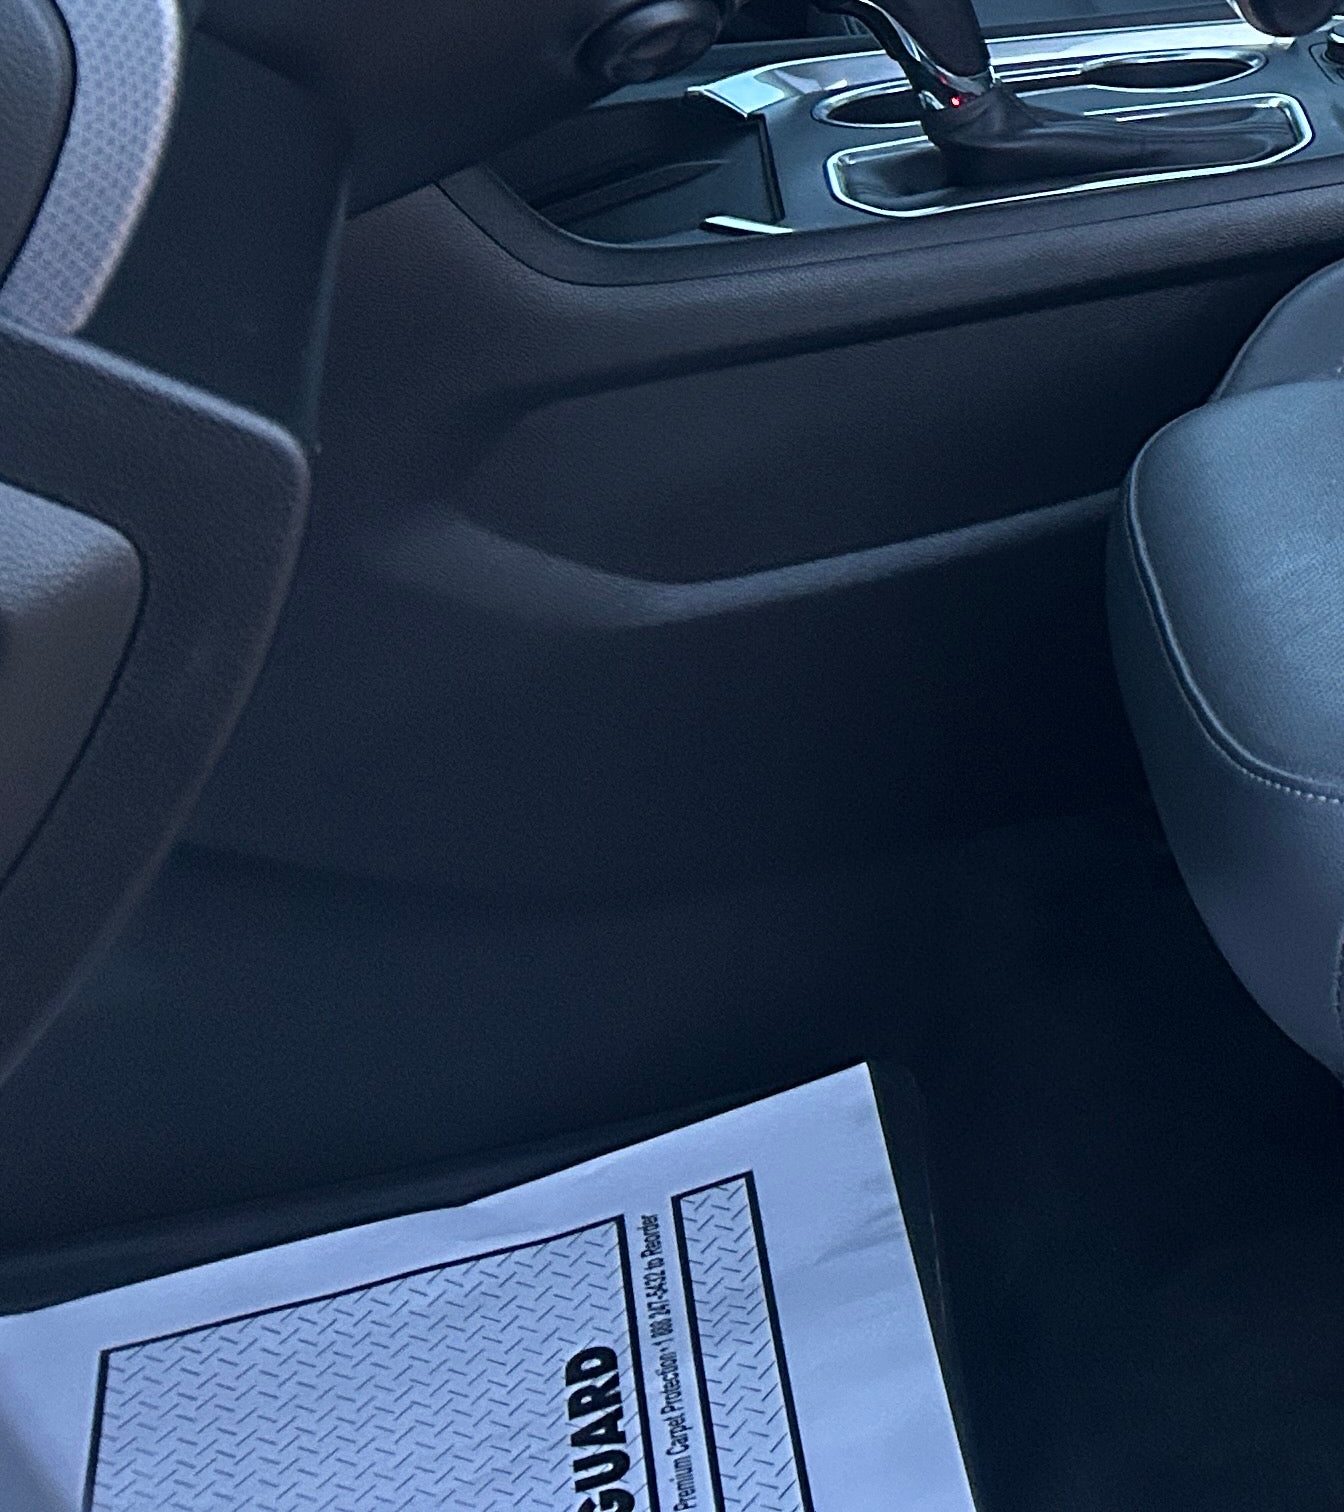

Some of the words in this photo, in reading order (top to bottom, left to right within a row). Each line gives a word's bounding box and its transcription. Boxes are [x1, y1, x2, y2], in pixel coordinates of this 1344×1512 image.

[637, 1214, 662, 1258] Reorder
[644, 1257, 664, 1270] to
[643, 1269, 671, 1319] 247-5432
[655, 1352, 684, 1414] Protection
[662, 1413, 693, 1455] Carpet
[669, 1455, 697, 1511] Premium
